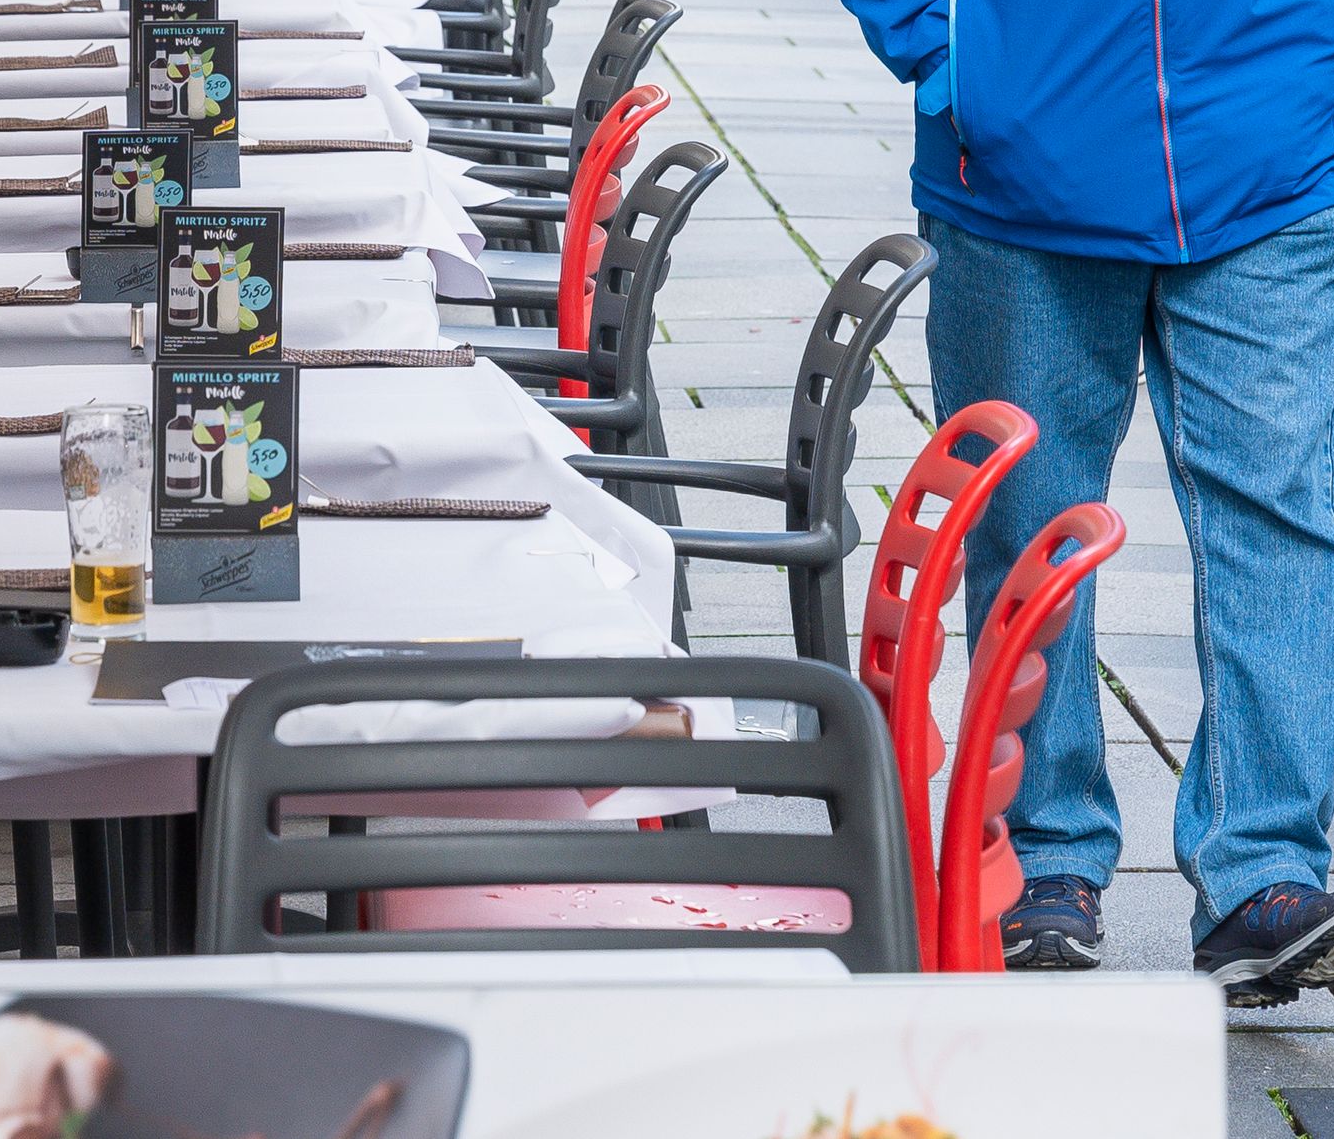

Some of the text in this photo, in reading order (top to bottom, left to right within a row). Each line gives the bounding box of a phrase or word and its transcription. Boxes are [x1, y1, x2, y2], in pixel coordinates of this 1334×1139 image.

[152, 27, 226, 35] MIRTILLO SPRITZ
[98, 136, 179, 145] MIRTILLO SPRITZ
[155, 187, 182, 199] 5,50
[175, 216, 267, 226] MIRTILLO SPRITZ
[240, 284, 271, 299] 5,50
[172, 372, 280, 383] MIRTILLO SPRITZ
